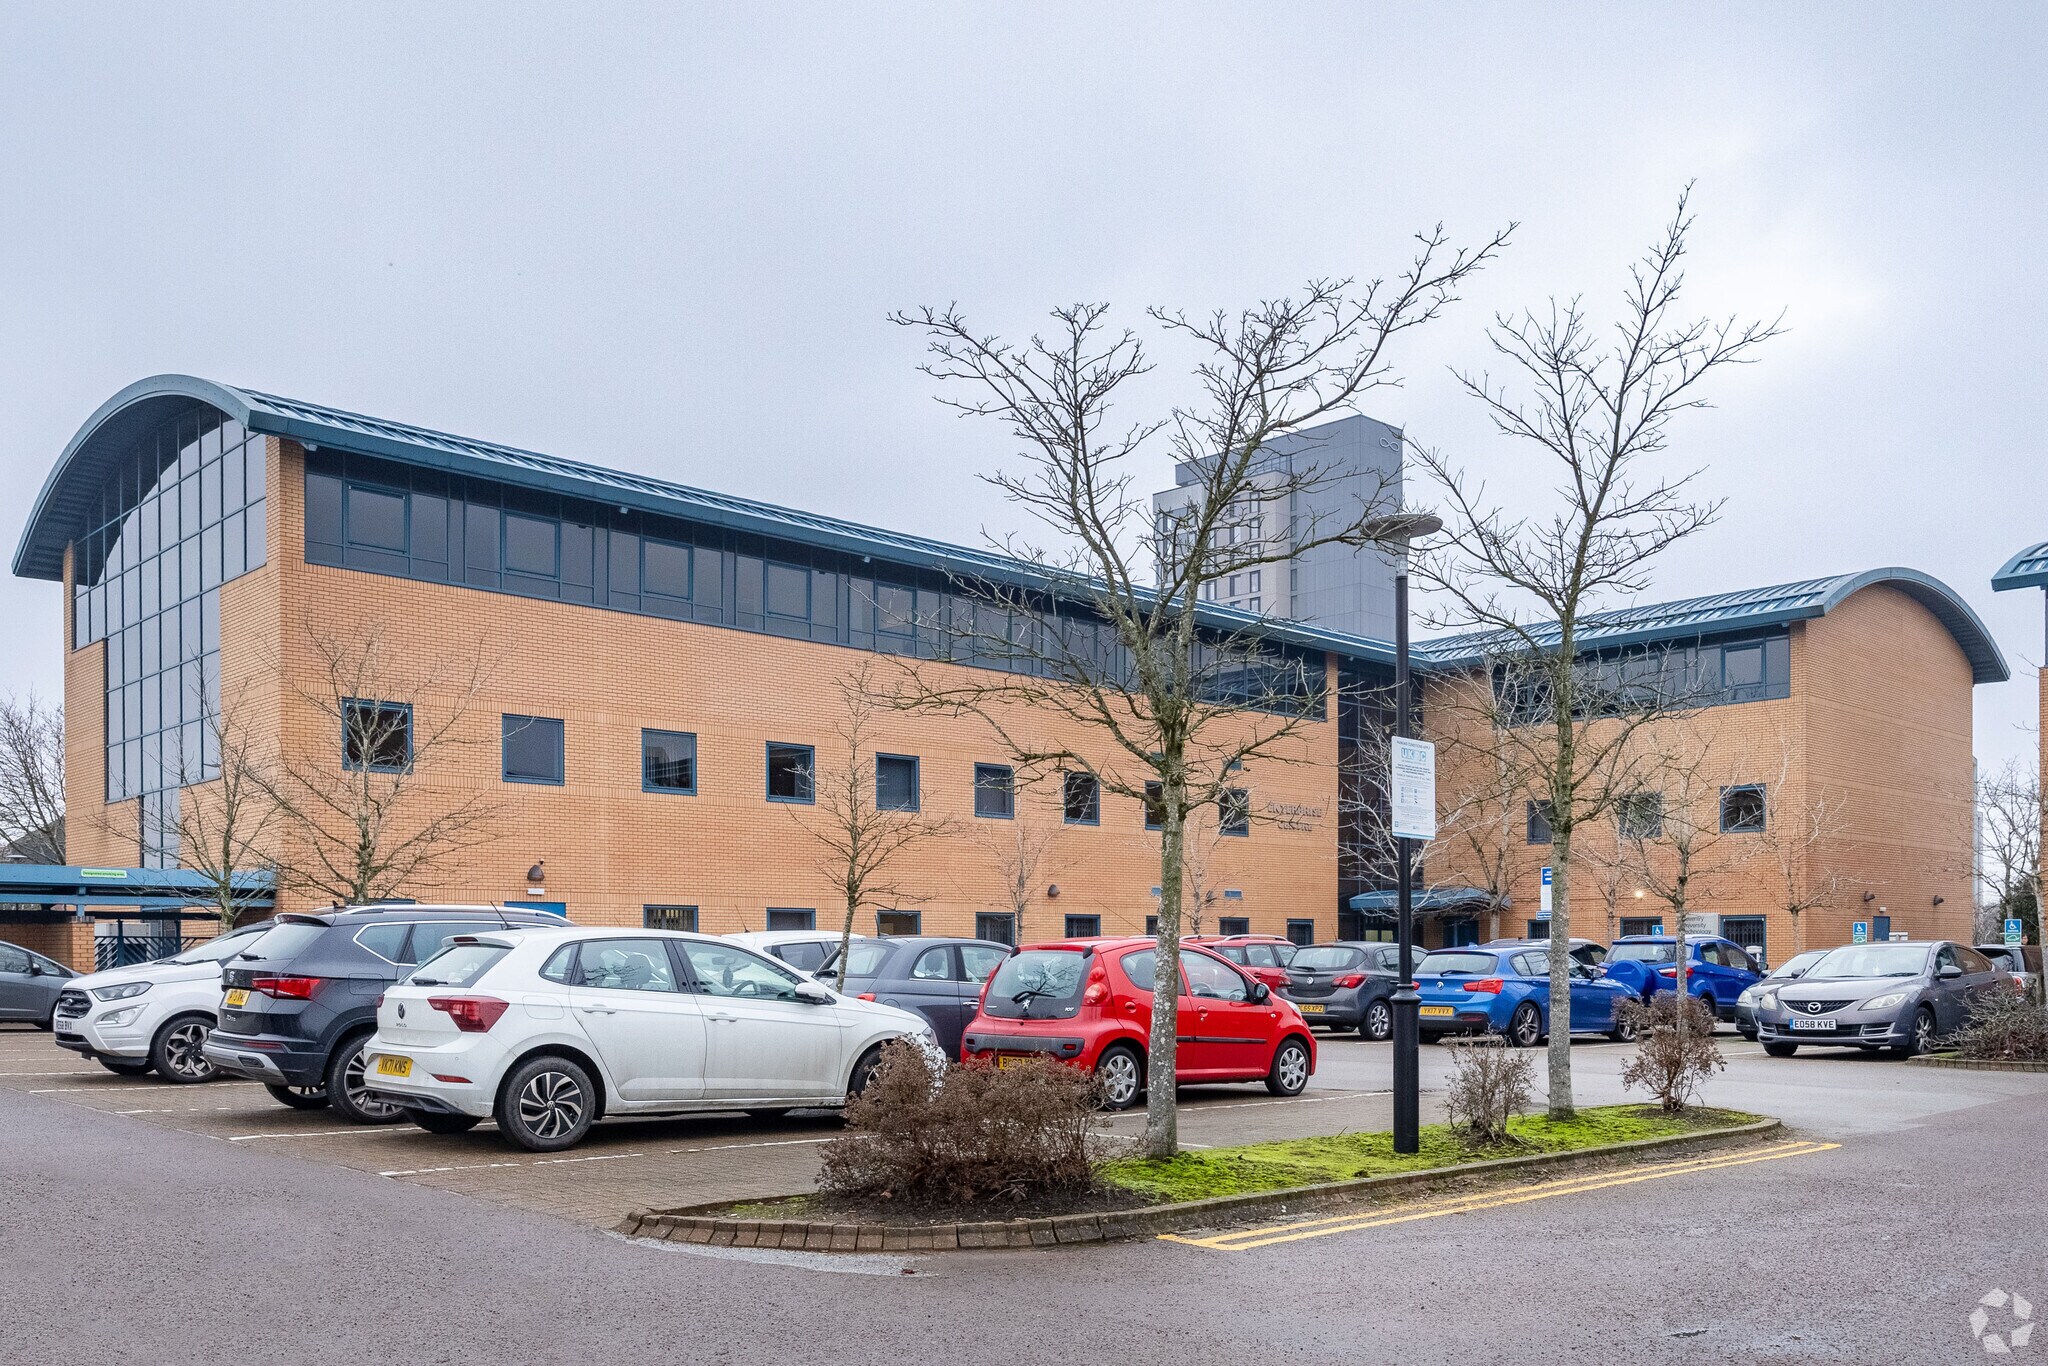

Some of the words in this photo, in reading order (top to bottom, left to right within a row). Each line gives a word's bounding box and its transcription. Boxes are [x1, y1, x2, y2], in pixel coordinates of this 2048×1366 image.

[1267, 802, 1323, 817] ENTERPRISE
[1818, 1020, 1834, 1028] KVE
[393, 1059, 408, 1074] KNS
